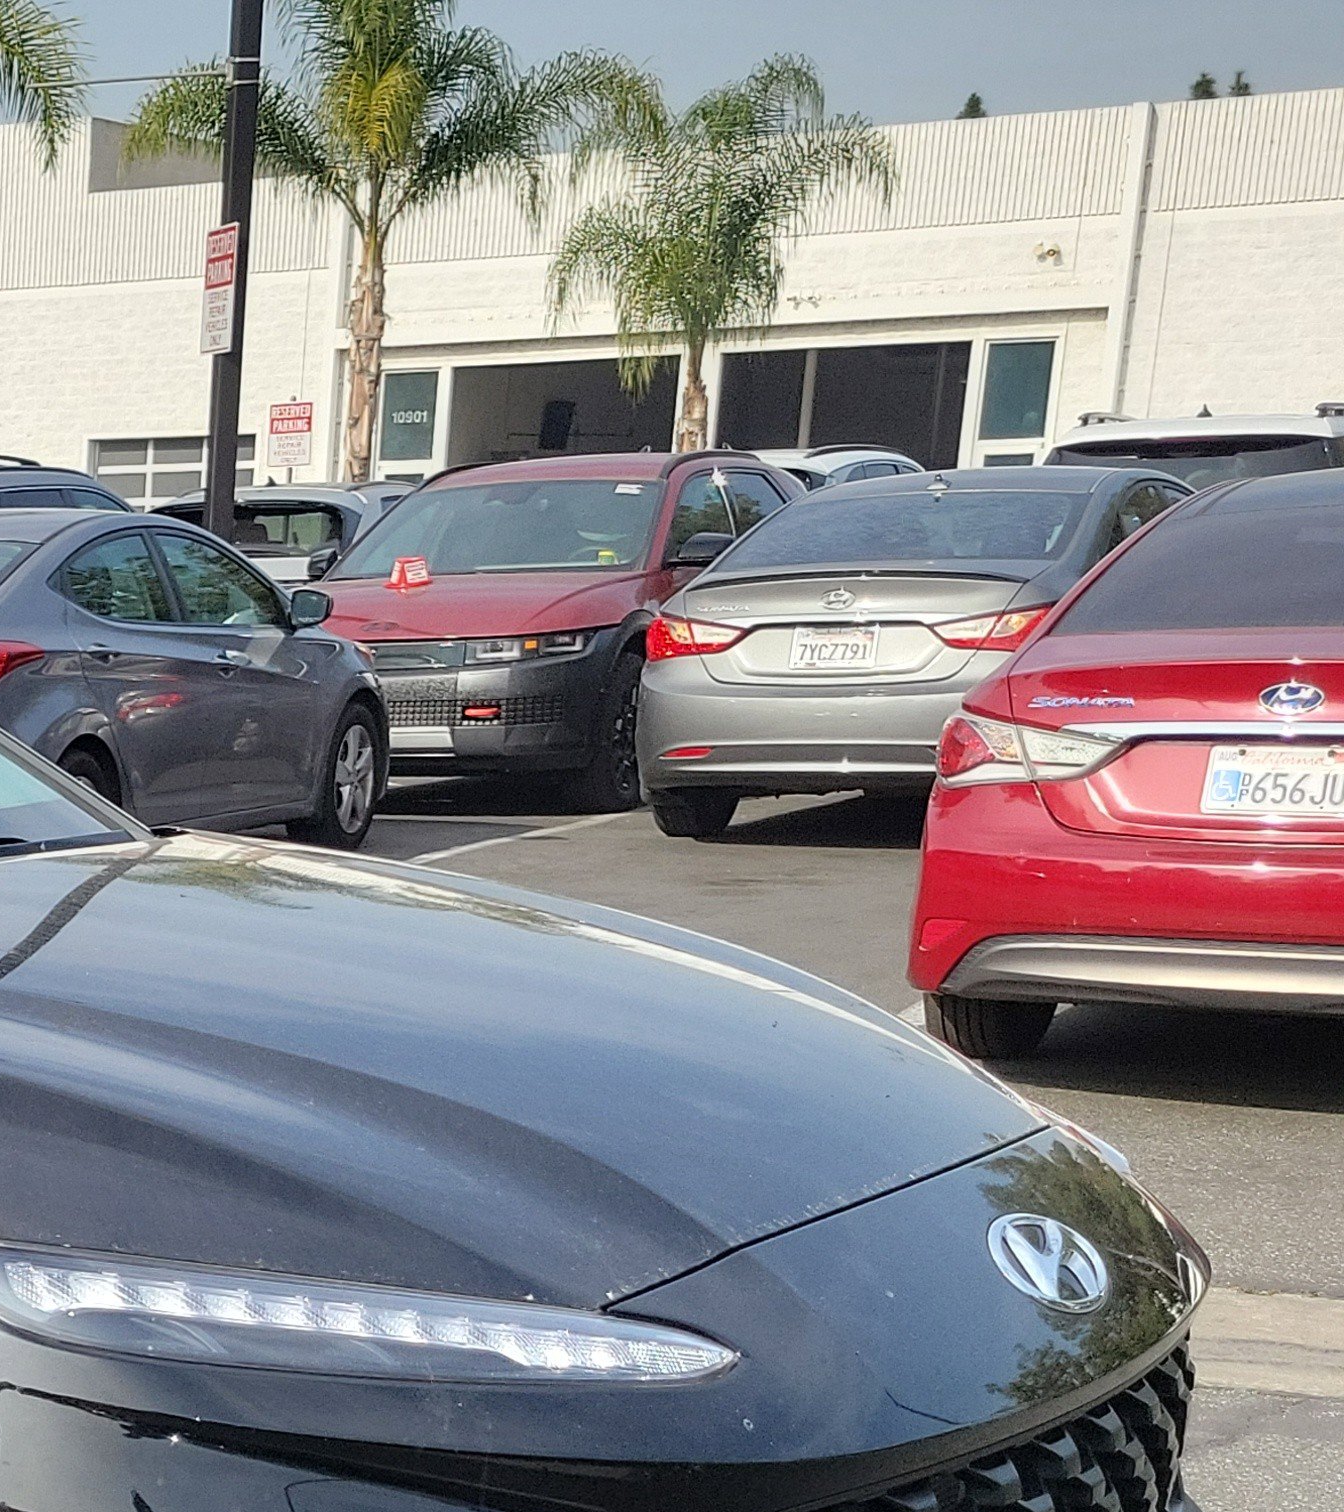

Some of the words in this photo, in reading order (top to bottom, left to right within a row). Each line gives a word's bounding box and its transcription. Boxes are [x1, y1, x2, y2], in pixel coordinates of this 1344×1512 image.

[206, 258, 233, 286] PARKING
[272, 405, 311, 418] RESERVED
[392, 410, 428, 424] 10901
[272, 418, 310, 433] PARKING
[799, 643, 868, 661] 7YCZ791
[1027, 696, 1135, 709] SONATA
